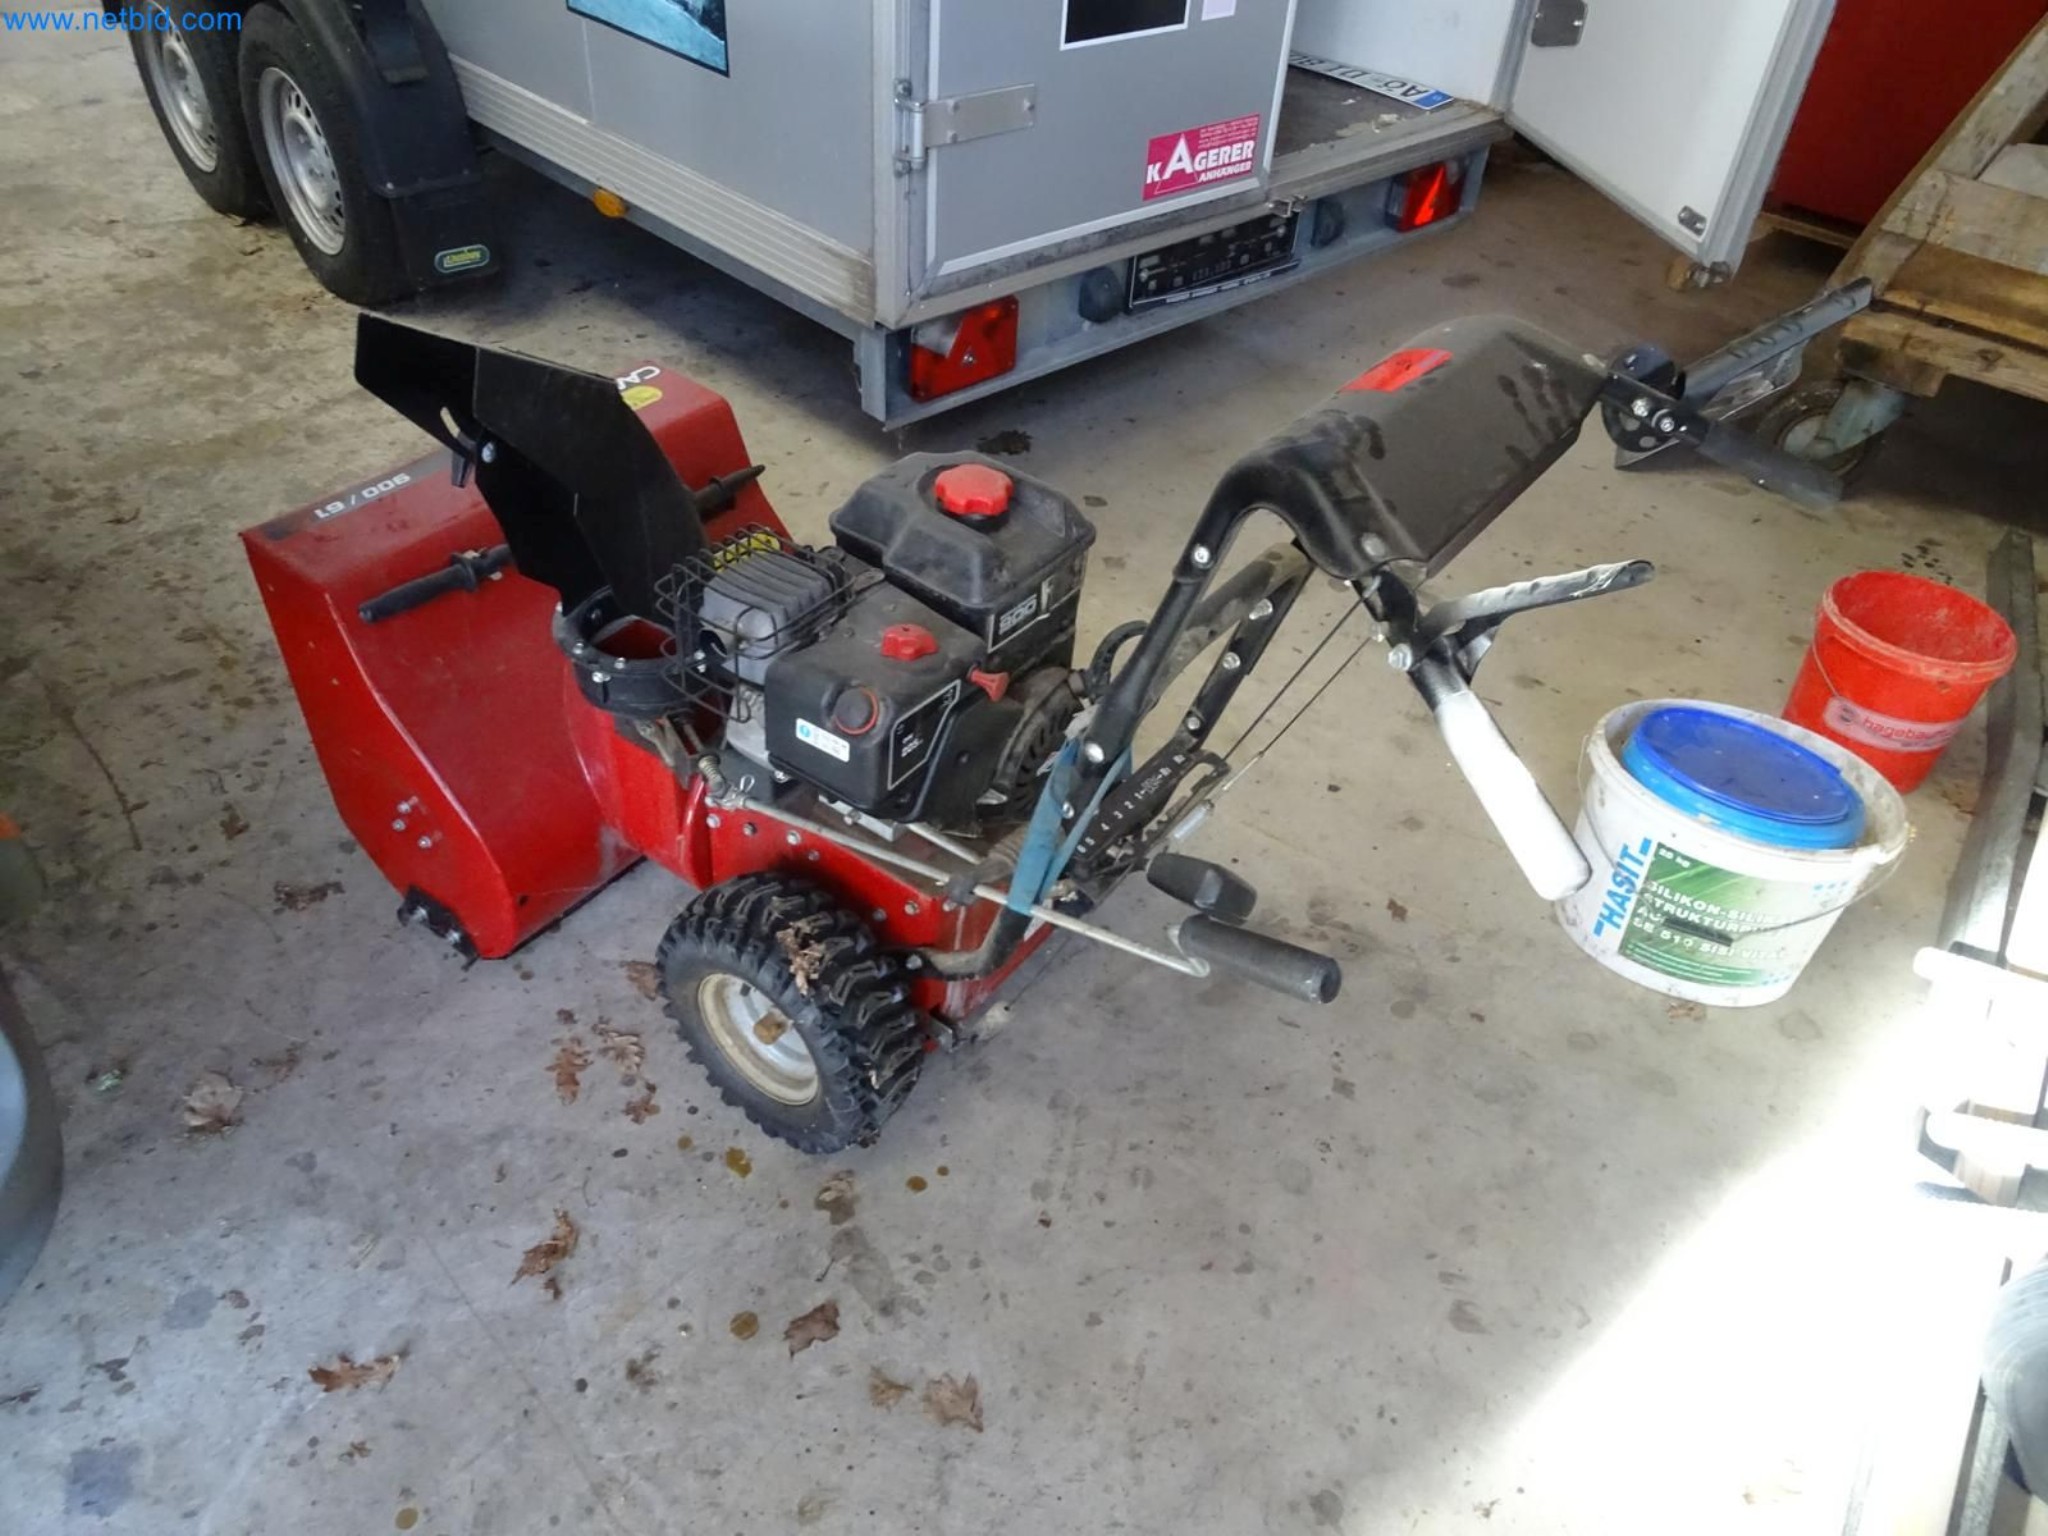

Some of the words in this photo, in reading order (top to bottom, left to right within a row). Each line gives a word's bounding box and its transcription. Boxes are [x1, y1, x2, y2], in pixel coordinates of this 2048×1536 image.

[1146, 132, 1255, 184] KAGERER
[361, 472, 411, 499] 900
[1600, 843, 1645, 930] HASIT
